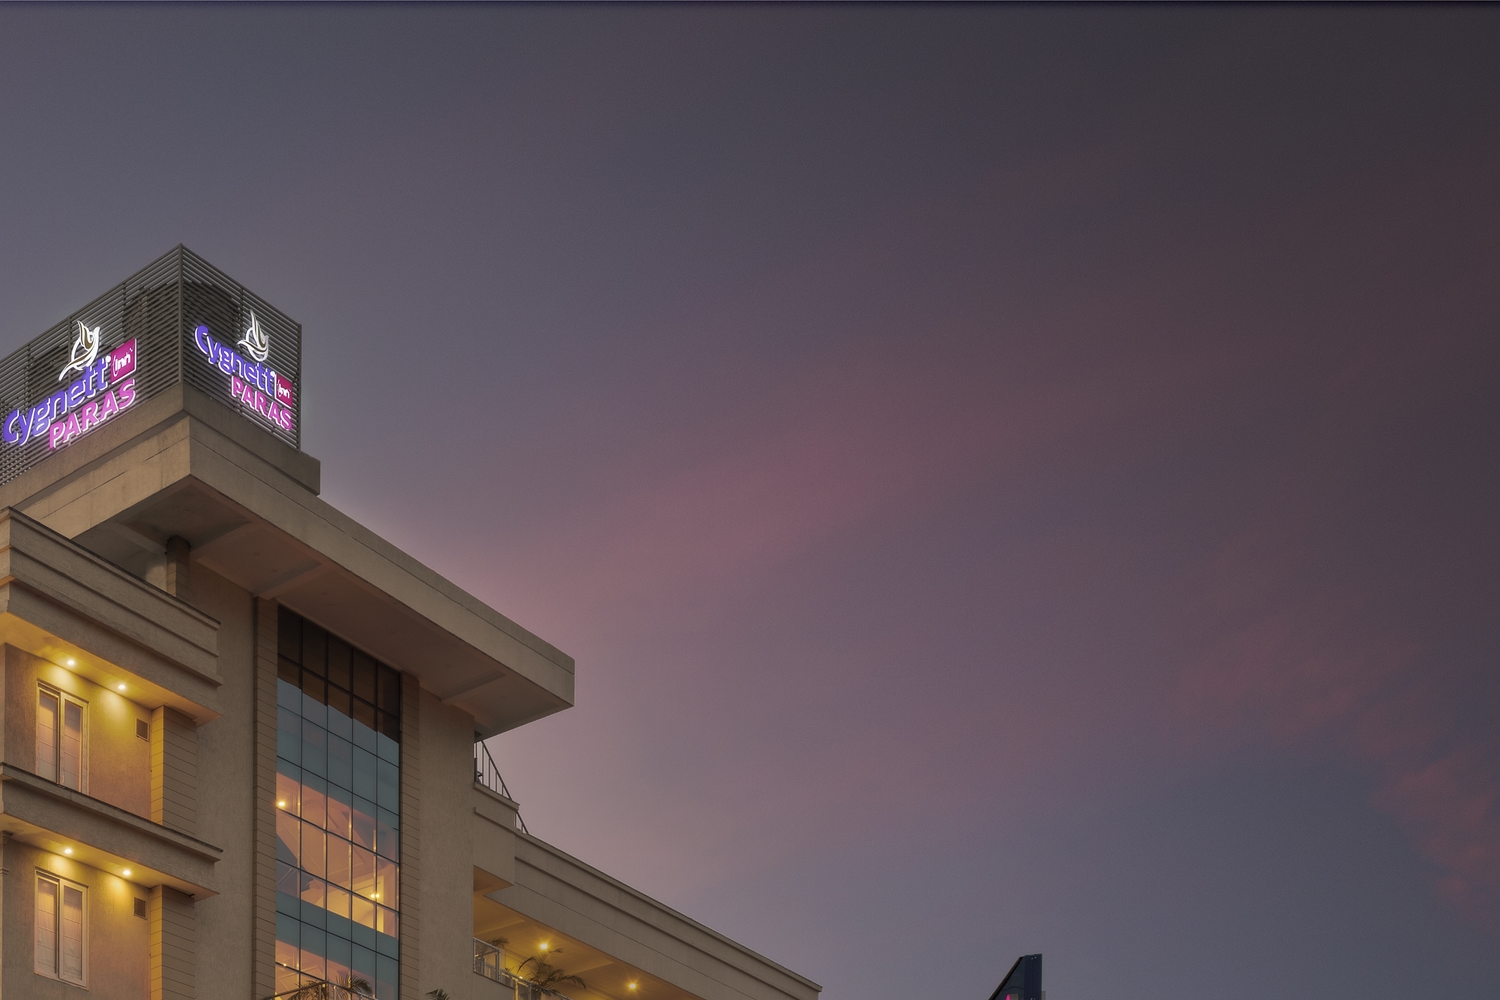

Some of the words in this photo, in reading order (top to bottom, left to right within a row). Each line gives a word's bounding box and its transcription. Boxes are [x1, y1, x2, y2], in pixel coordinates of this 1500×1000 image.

[195, 325, 274, 397] Cygnett
[3, 357, 108, 445] Cygnett
[49, 379, 136, 450] PARAS
[231, 375, 293, 431] PARAS
